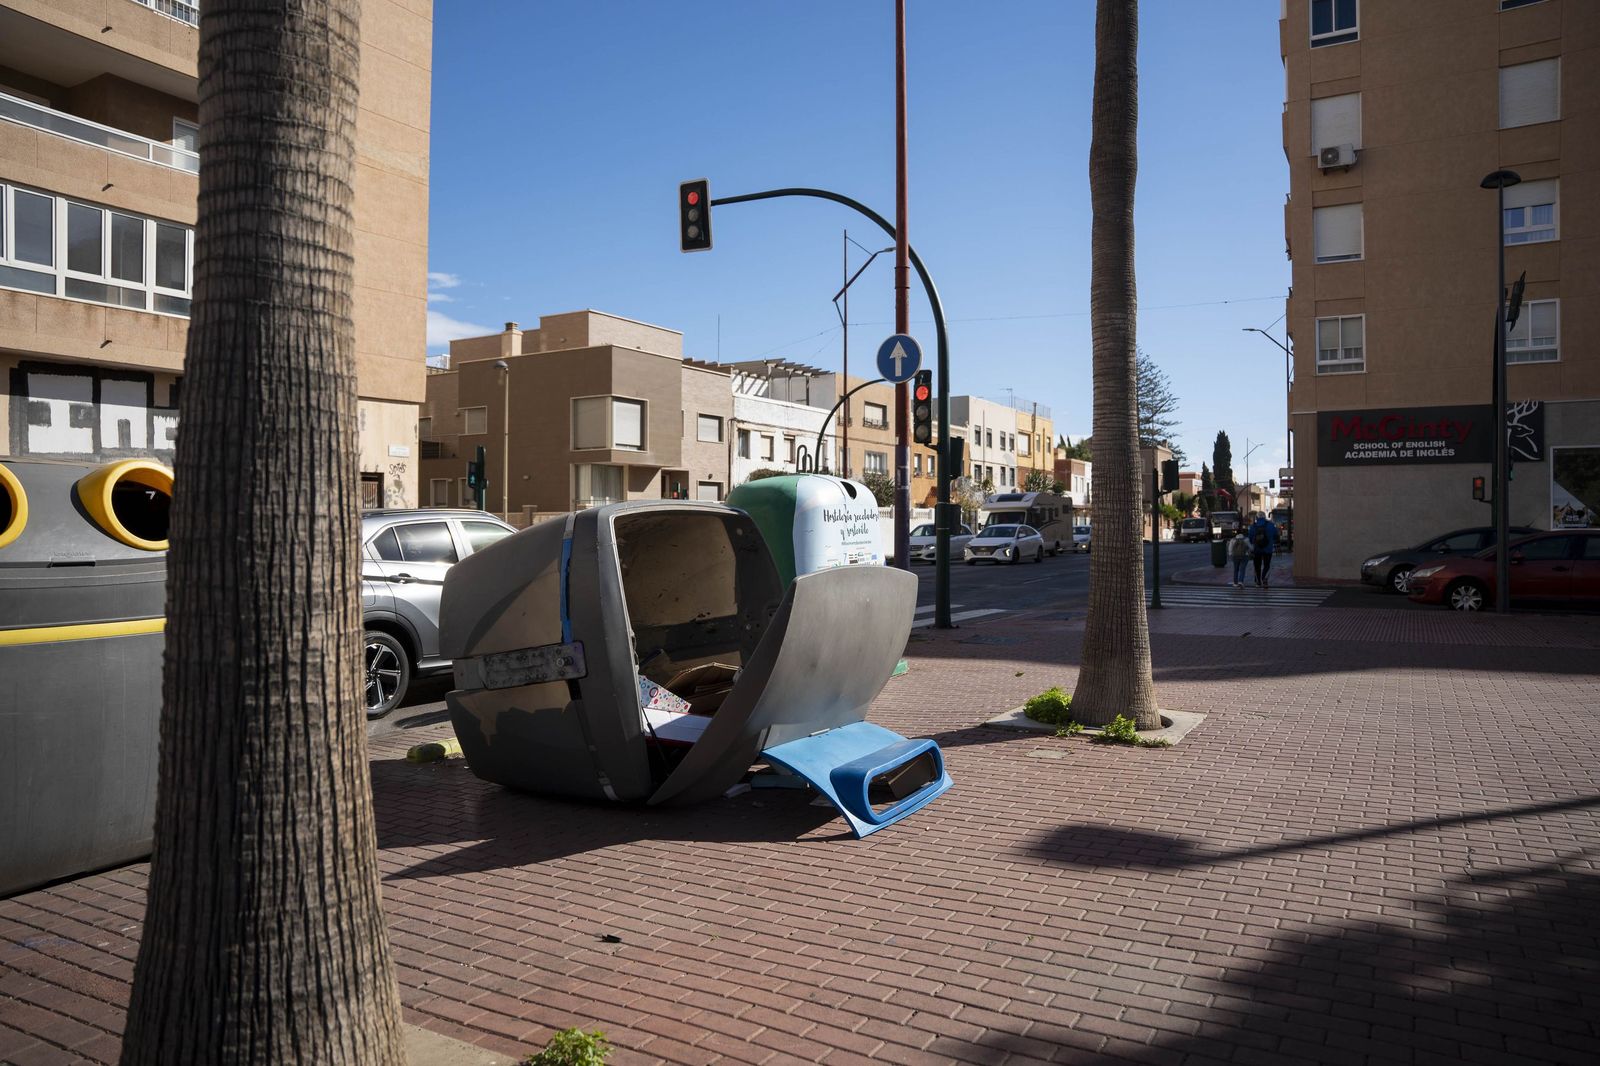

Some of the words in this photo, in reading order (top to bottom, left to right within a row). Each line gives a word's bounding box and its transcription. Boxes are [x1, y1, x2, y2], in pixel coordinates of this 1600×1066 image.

[1331, 414, 1473, 443] McGinty
[1353, 442, 1389, 450] SCHOOL
[1405, 440, 1446, 449] ENGLISH
[1344, 450, 1397, 459] ACADEMIA
[1399, 450, 1414, 458] DE
[1416, 448, 1455, 457] INGLÉS
